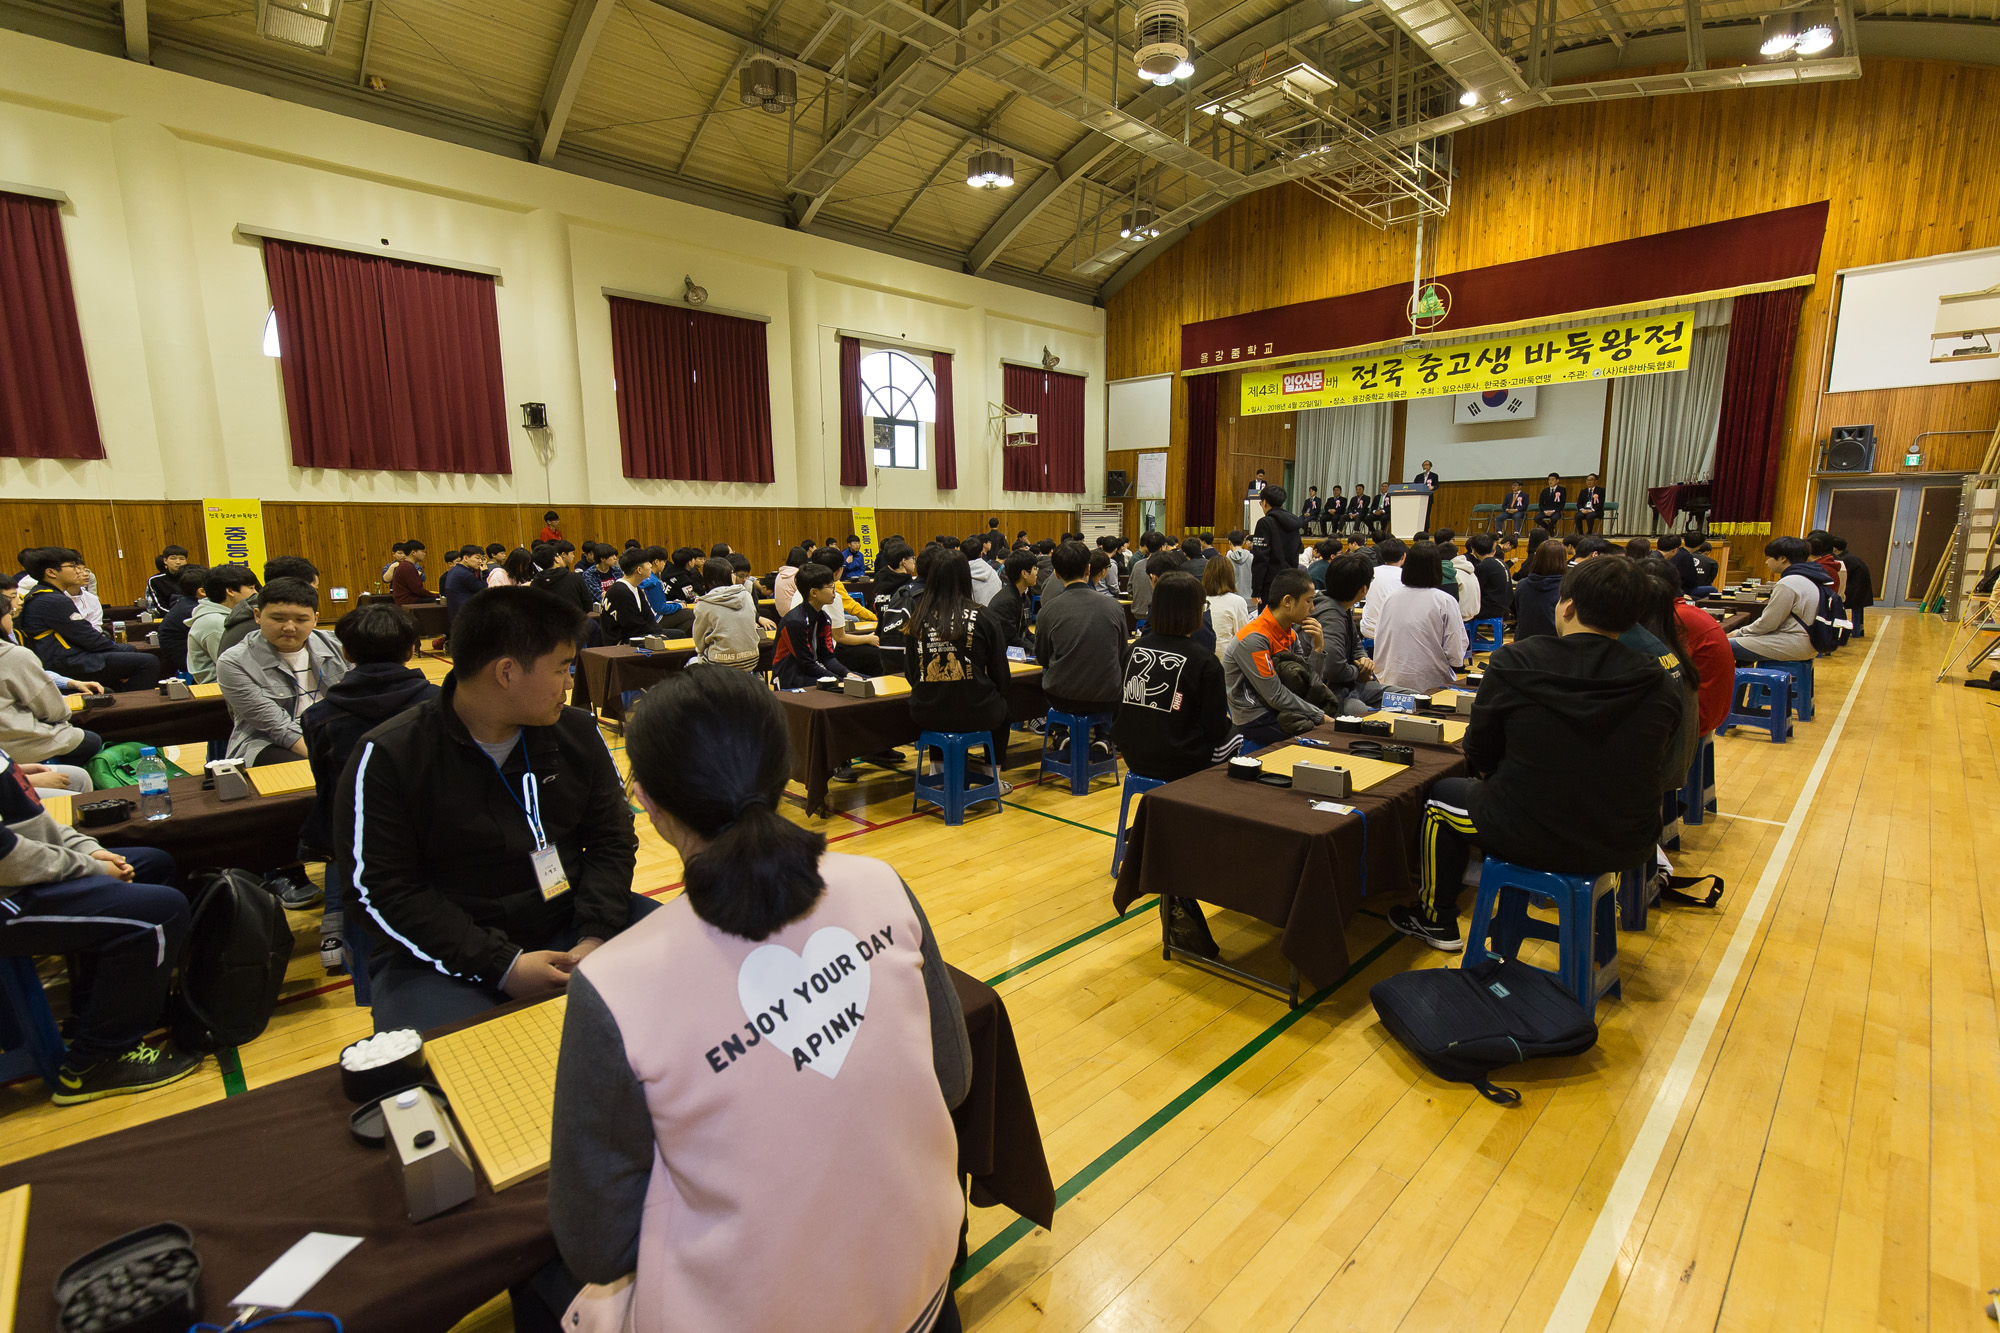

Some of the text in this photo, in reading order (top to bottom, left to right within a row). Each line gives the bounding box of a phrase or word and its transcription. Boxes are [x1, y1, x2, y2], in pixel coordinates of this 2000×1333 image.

[1247, 320, 1685, 397] 제4회 일요신문 배 전국 중고생 바둑왕전
[1602, 359, 1676, 377] (사)대한바둑협회
[1352, 393, 1385, 404] 용강중학교
[1386, 390, 1408, 400] 체육관
[1267, 404, 1286, 412] 2018년
[1287, 402, 1297, 410] 4월
[861, 524, 872, 545] 중등
[714, 653, 735, 661] ADIDAS
[705, 925, 895, 1074] ENJOY YOUR DAY
[792, 1002, 865, 1072] APINK
